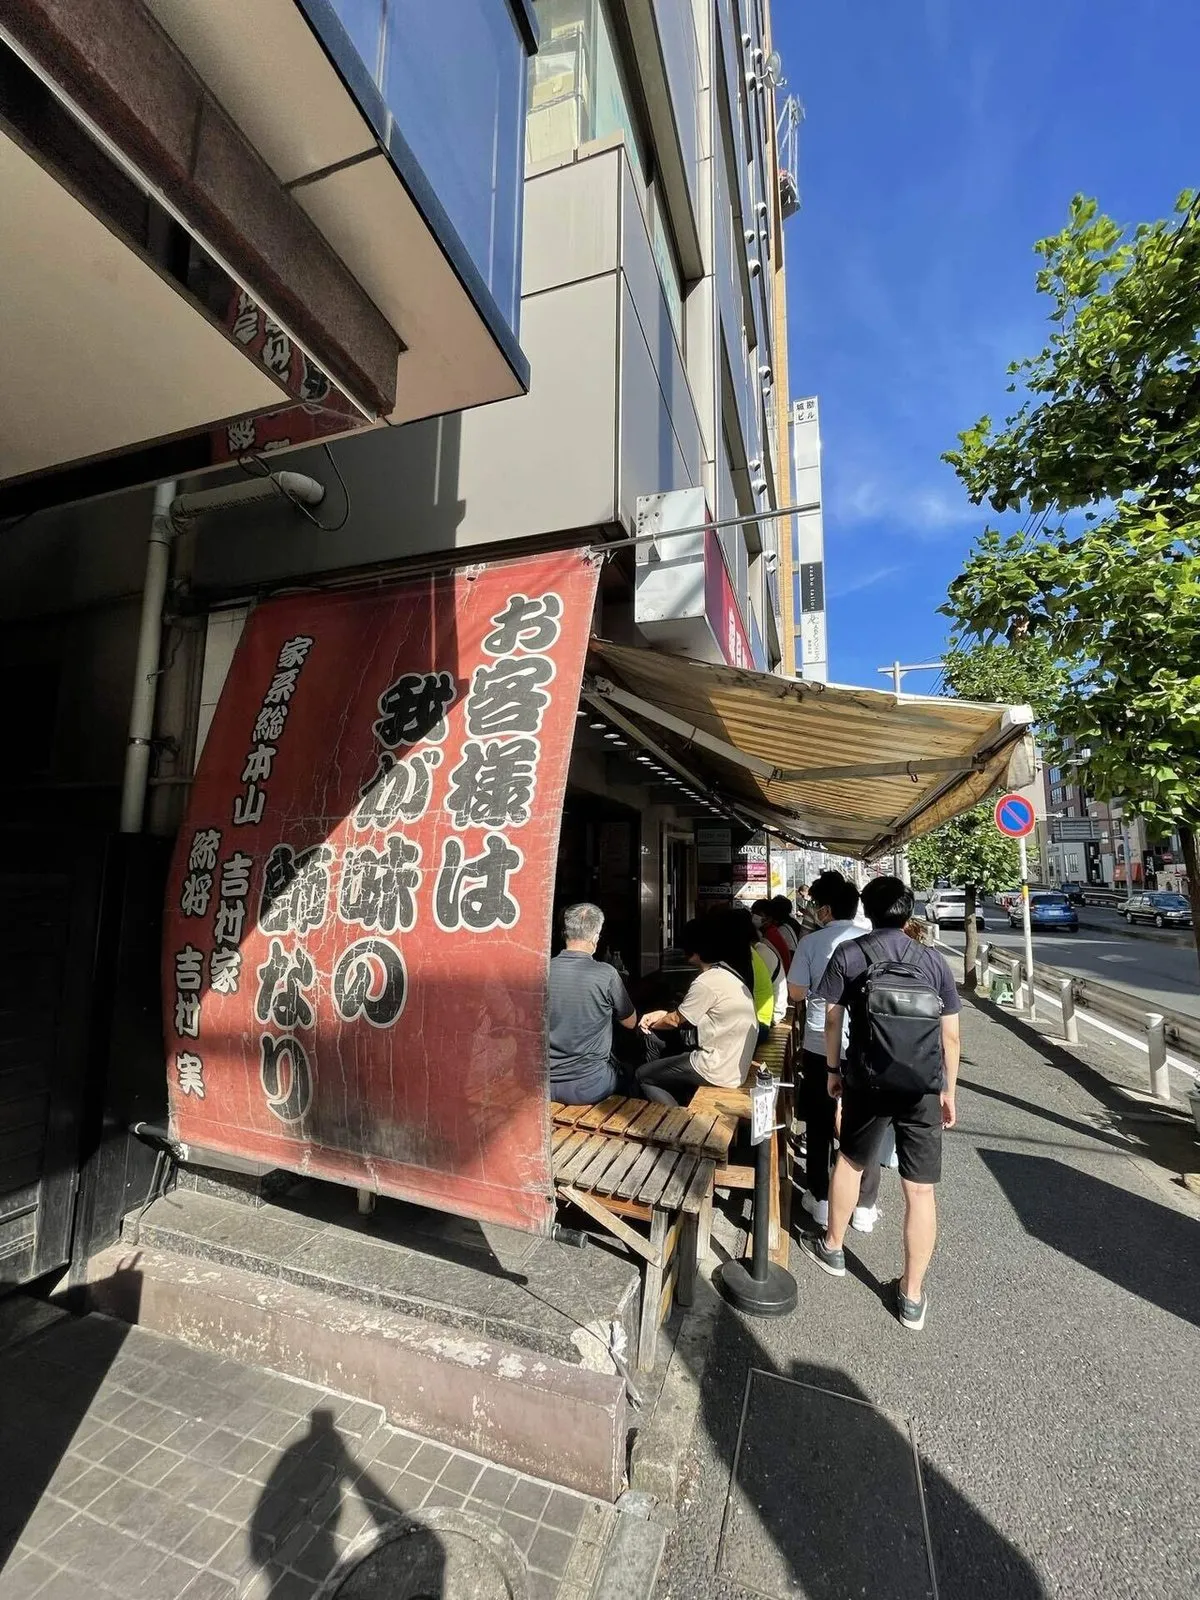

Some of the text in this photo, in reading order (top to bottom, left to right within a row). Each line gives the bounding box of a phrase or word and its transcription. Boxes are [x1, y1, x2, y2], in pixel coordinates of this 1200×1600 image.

[181, 829, 222, 917] 統将
[210, 636, 314, 994] 家系総本山 吉村家
[333, 671, 457, 1029] 我が味の
[432, 591, 564, 934] お客様は
[175, 946, 204, 1039] 吉村
[255, 842, 332, 1125] 師なり
